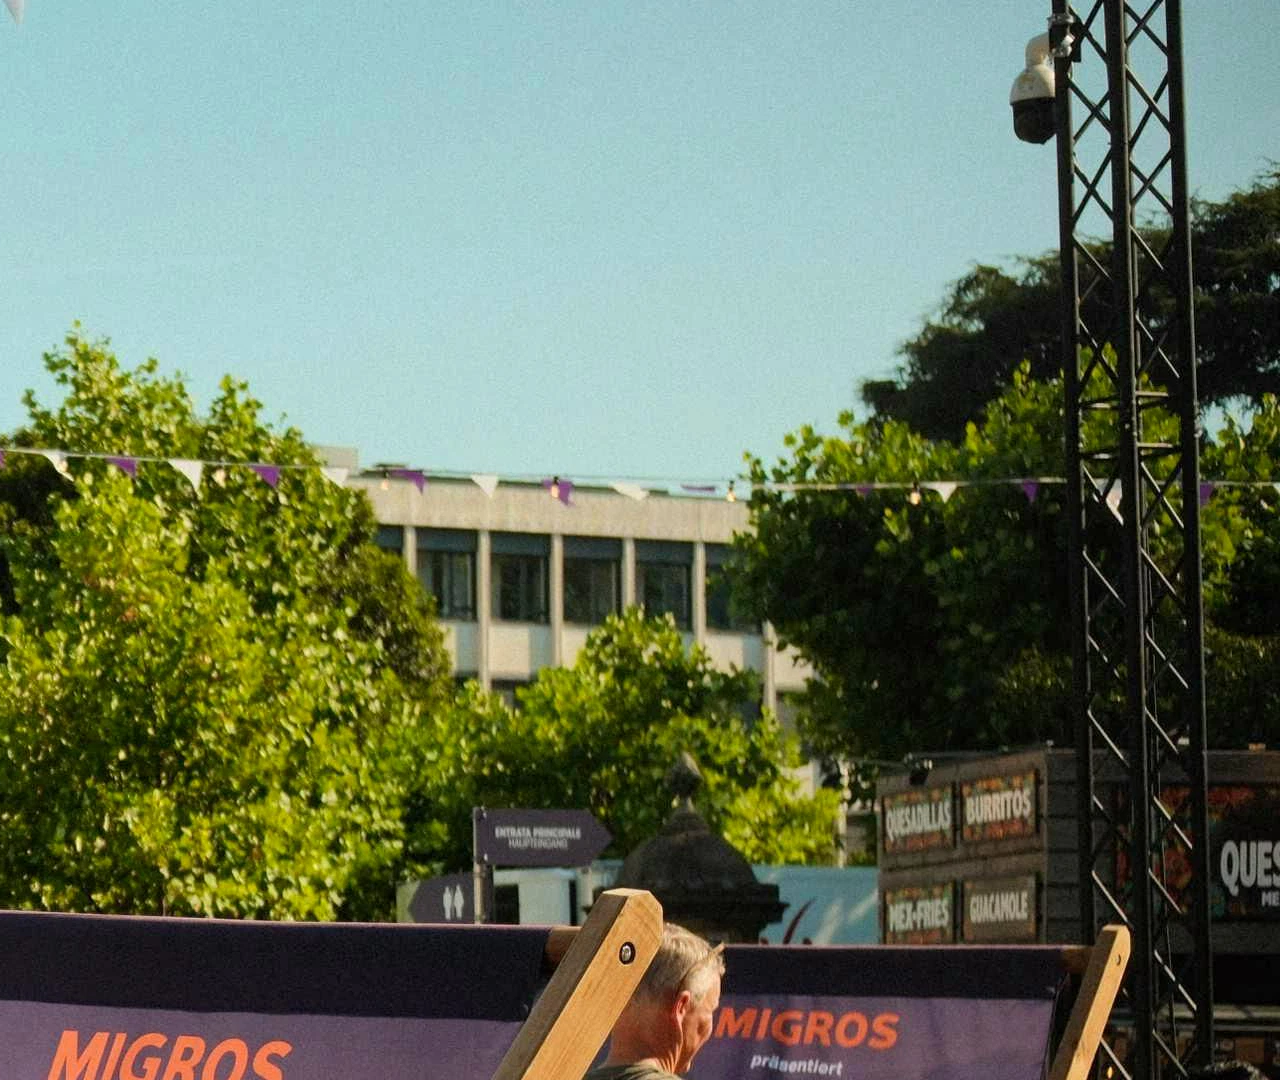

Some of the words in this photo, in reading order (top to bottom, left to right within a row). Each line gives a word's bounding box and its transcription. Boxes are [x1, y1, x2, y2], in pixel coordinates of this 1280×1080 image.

[886, 800, 952, 842] QUESADILLAS
[966, 787, 1032, 826] BURRITOS
[495, 826, 532, 838] ENTRATA
[533, 826, 581, 839] PRINCIPALE
[969, 891, 1029, 924] GUACAMOLE
[713, 1007, 901, 1050] MIGROS
[749, 1053, 844, 1077] präsentiert
